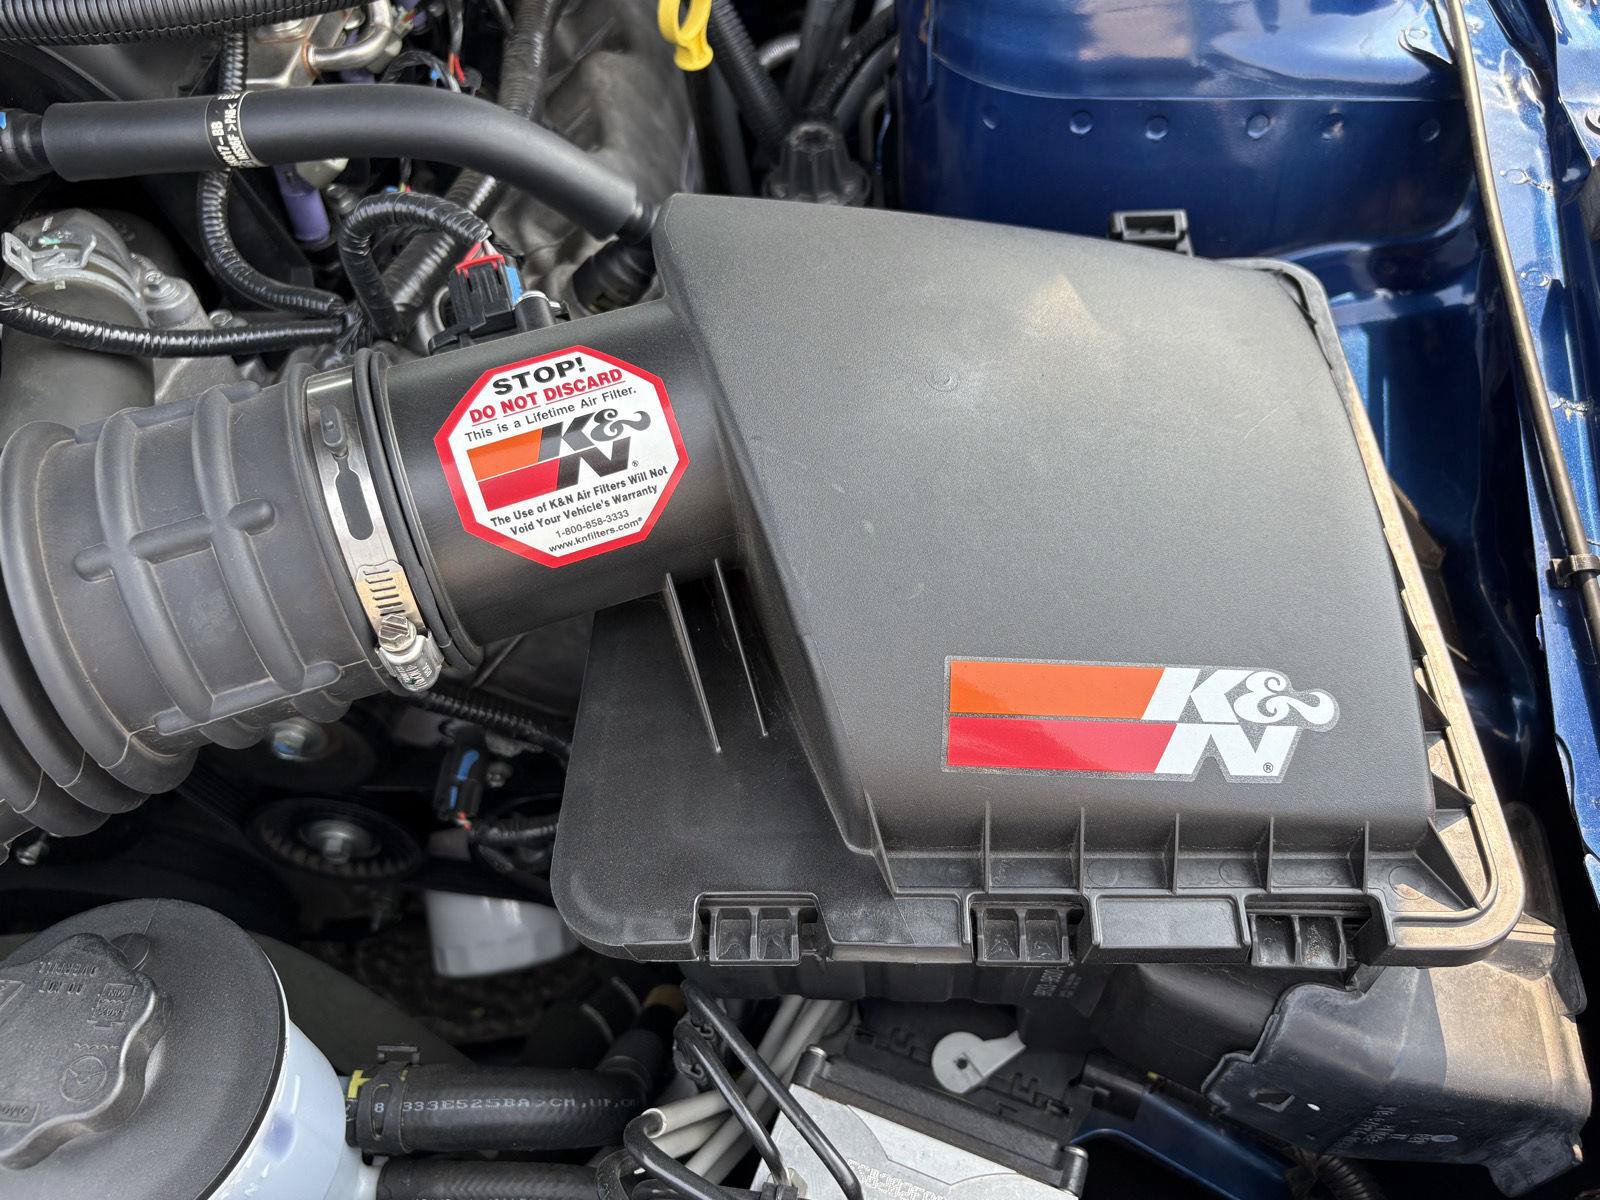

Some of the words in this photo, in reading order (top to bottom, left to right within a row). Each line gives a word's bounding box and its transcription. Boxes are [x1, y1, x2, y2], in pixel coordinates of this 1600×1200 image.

[469, 405, 497, 424] DO
[500, 392, 539, 415] NOT
[543, 368, 623, 401] DISCARD
[492, 356, 586, 395] STOP!
[464, 428, 493, 443] This
[497, 423, 508, 433] is
[513, 419, 521, 428] a
[525, 404, 576, 425] Lifetime
[580, 397, 598, 409] Air
[602, 386, 637, 402] Filter.
[490, 515, 511, 527] The
[513, 508, 535, 521] Use
[537, 502, 548, 514] of
[549, 495, 574, 510] K&N
[577, 489, 591, 501] Air
[593, 479, 626, 496] Filters
[628, 472, 648, 486] Will
[650, 466, 669, 478] Not
[510, 520, 535, 536] Void
[536, 514, 561, 531] Your
[563, 500, 611, 521] Vehicle's
[612, 484, 659, 506] Warranty
[556, 509, 630, 538] 1-800-858-3333
